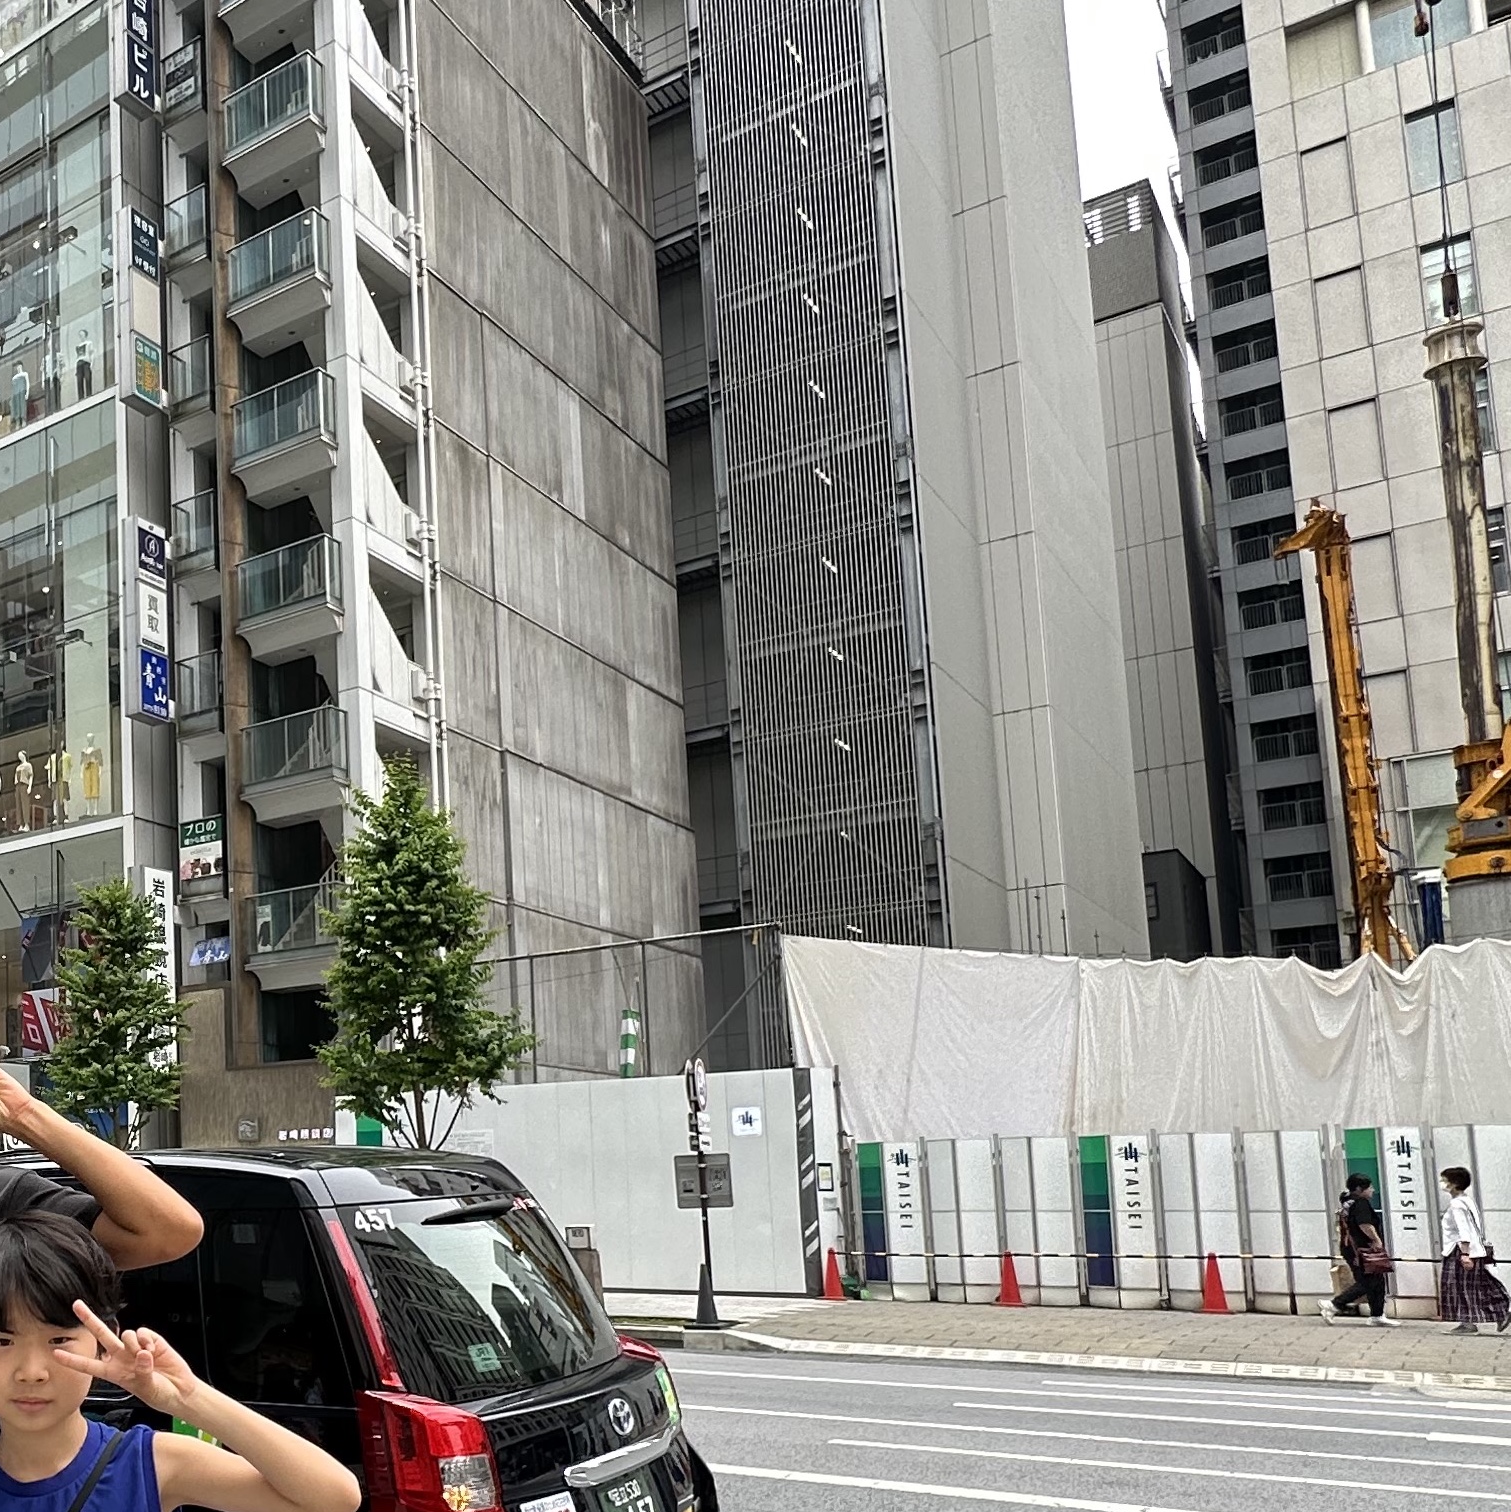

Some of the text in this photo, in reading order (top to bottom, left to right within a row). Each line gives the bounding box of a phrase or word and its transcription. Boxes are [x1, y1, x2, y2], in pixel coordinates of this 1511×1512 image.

[184, 820, 216, 836] プロの
[354, 1208, 395, 1233] 457
[897, 1171, 913, 1228] TAISEI
[1124, 1167, 1143, 1229] TAISEI
[1397, 1163, 1417, 1231] TAISEI
